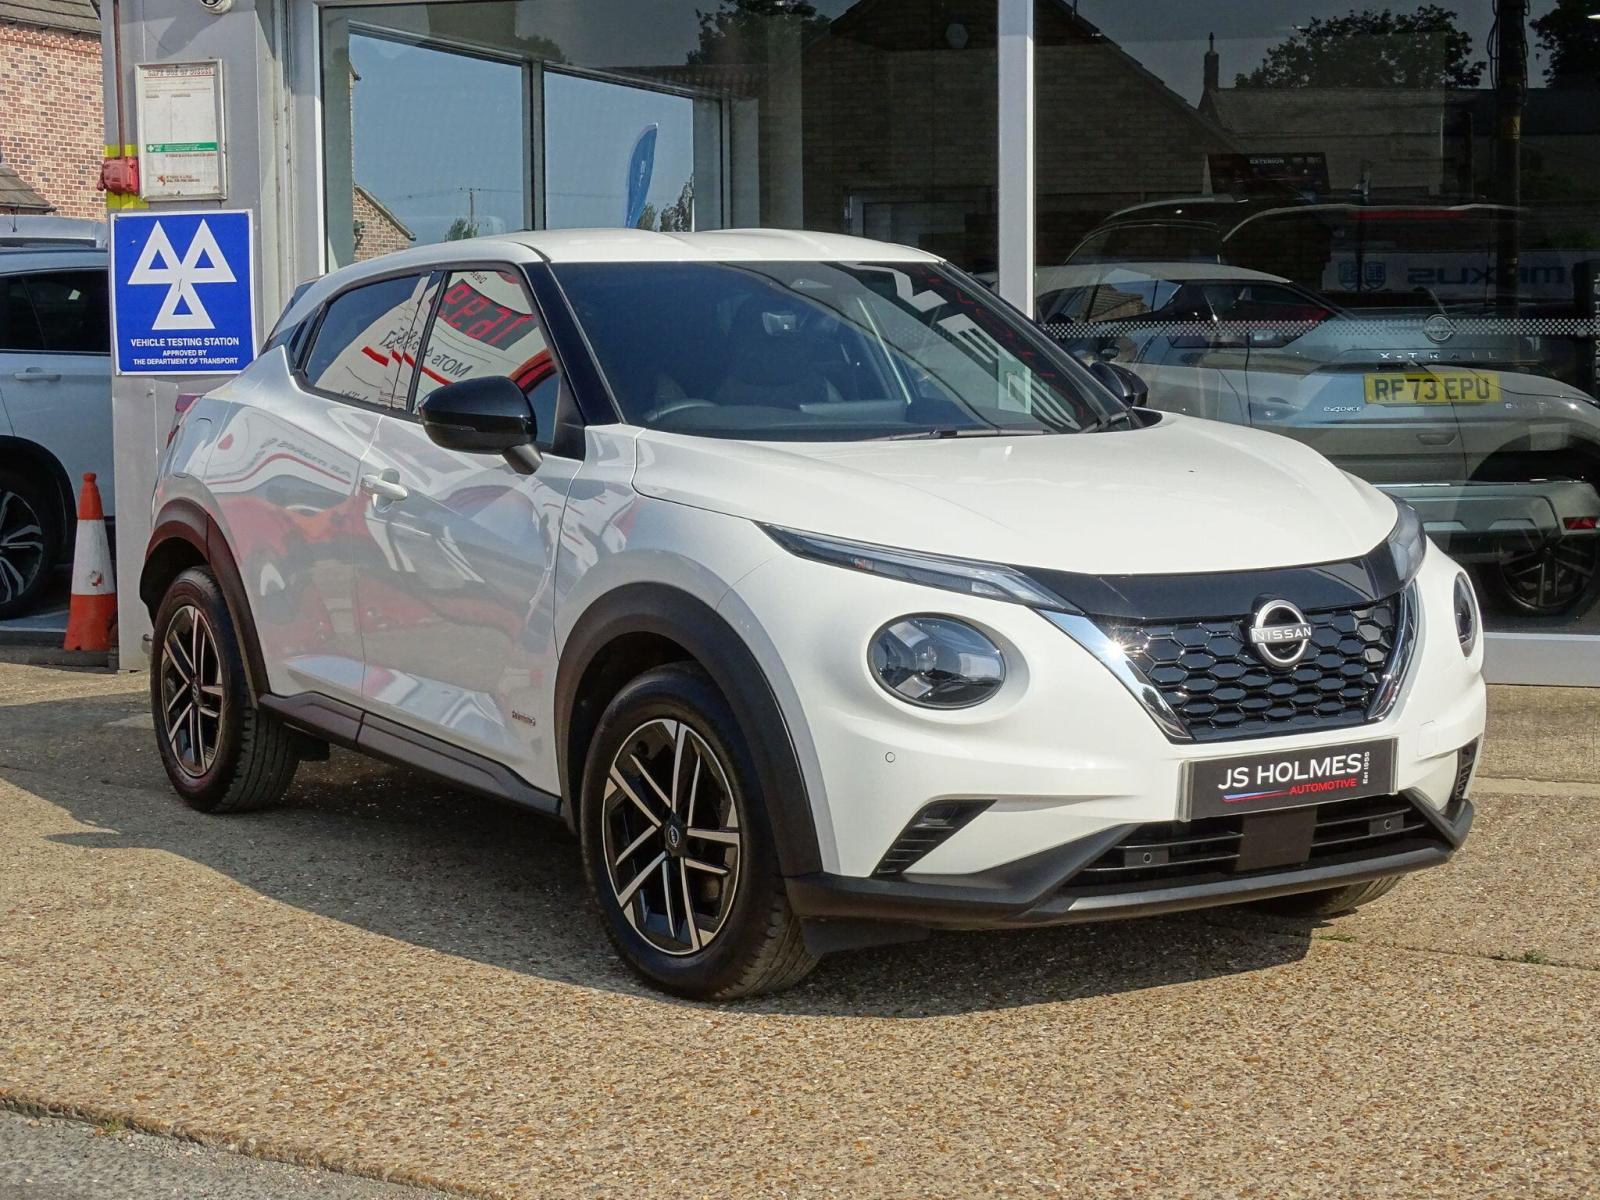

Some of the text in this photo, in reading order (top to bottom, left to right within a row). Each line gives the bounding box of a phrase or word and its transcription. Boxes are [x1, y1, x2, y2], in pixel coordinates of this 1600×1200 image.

[130, 337, 240, 347] VEHICLE TESTING STATION
[162, 349, 197, 357] APPROVED
[1374, 377, 1491, 401] RF73 EPU
[1254, 626, 1312, 641] NISSAN
[1217, 753, 1362, 790] JS HOLMES
[1289, 778, 1357, 796] AUTOMOTIVE
